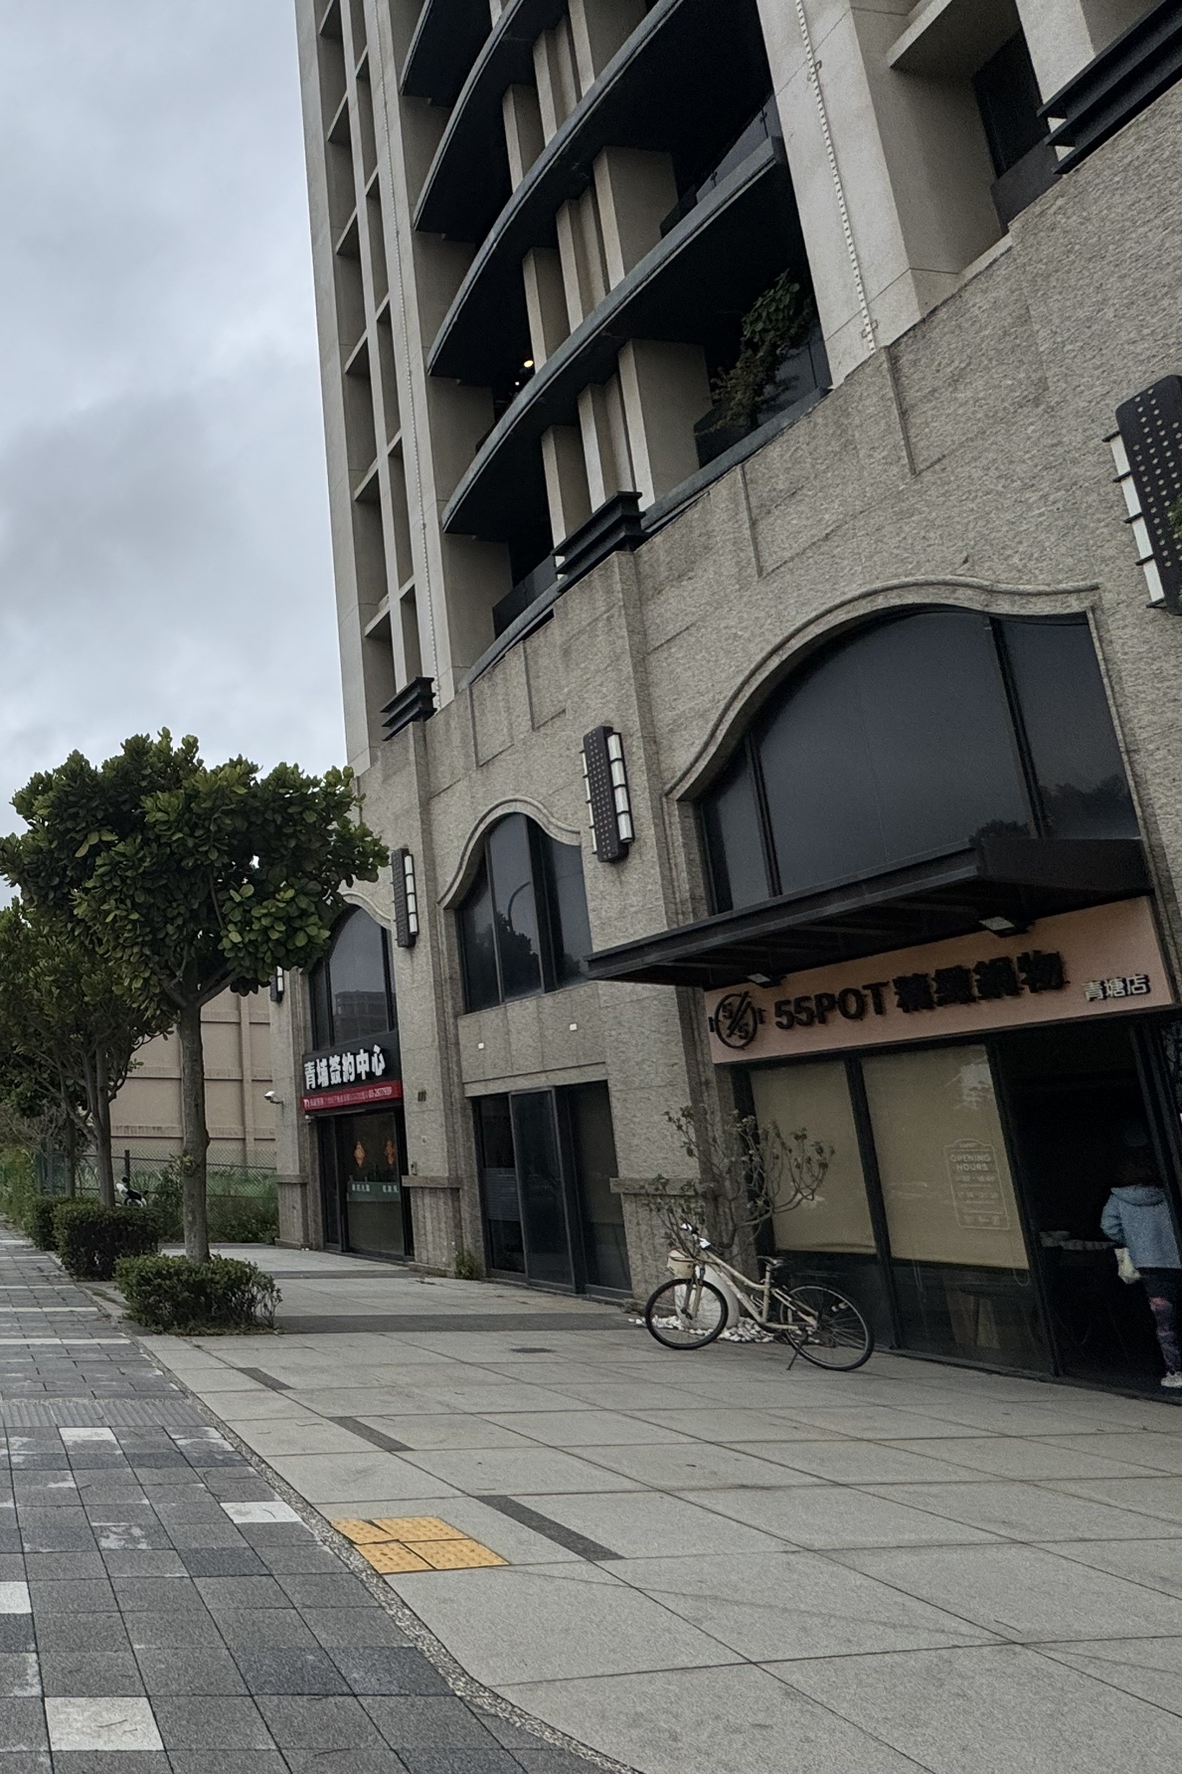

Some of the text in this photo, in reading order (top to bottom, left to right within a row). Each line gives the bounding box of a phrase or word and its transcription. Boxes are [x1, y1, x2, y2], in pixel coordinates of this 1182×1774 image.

[1082, 975, 1149, 1001] 青塘店
[774, 981, 889, 1030] 55POT
[304, 1044, 386, 1090] 青埔簽約中心
[949, 1154, 992, 1163] OPENING
[956, 1163, 989, 1171] HOURS
